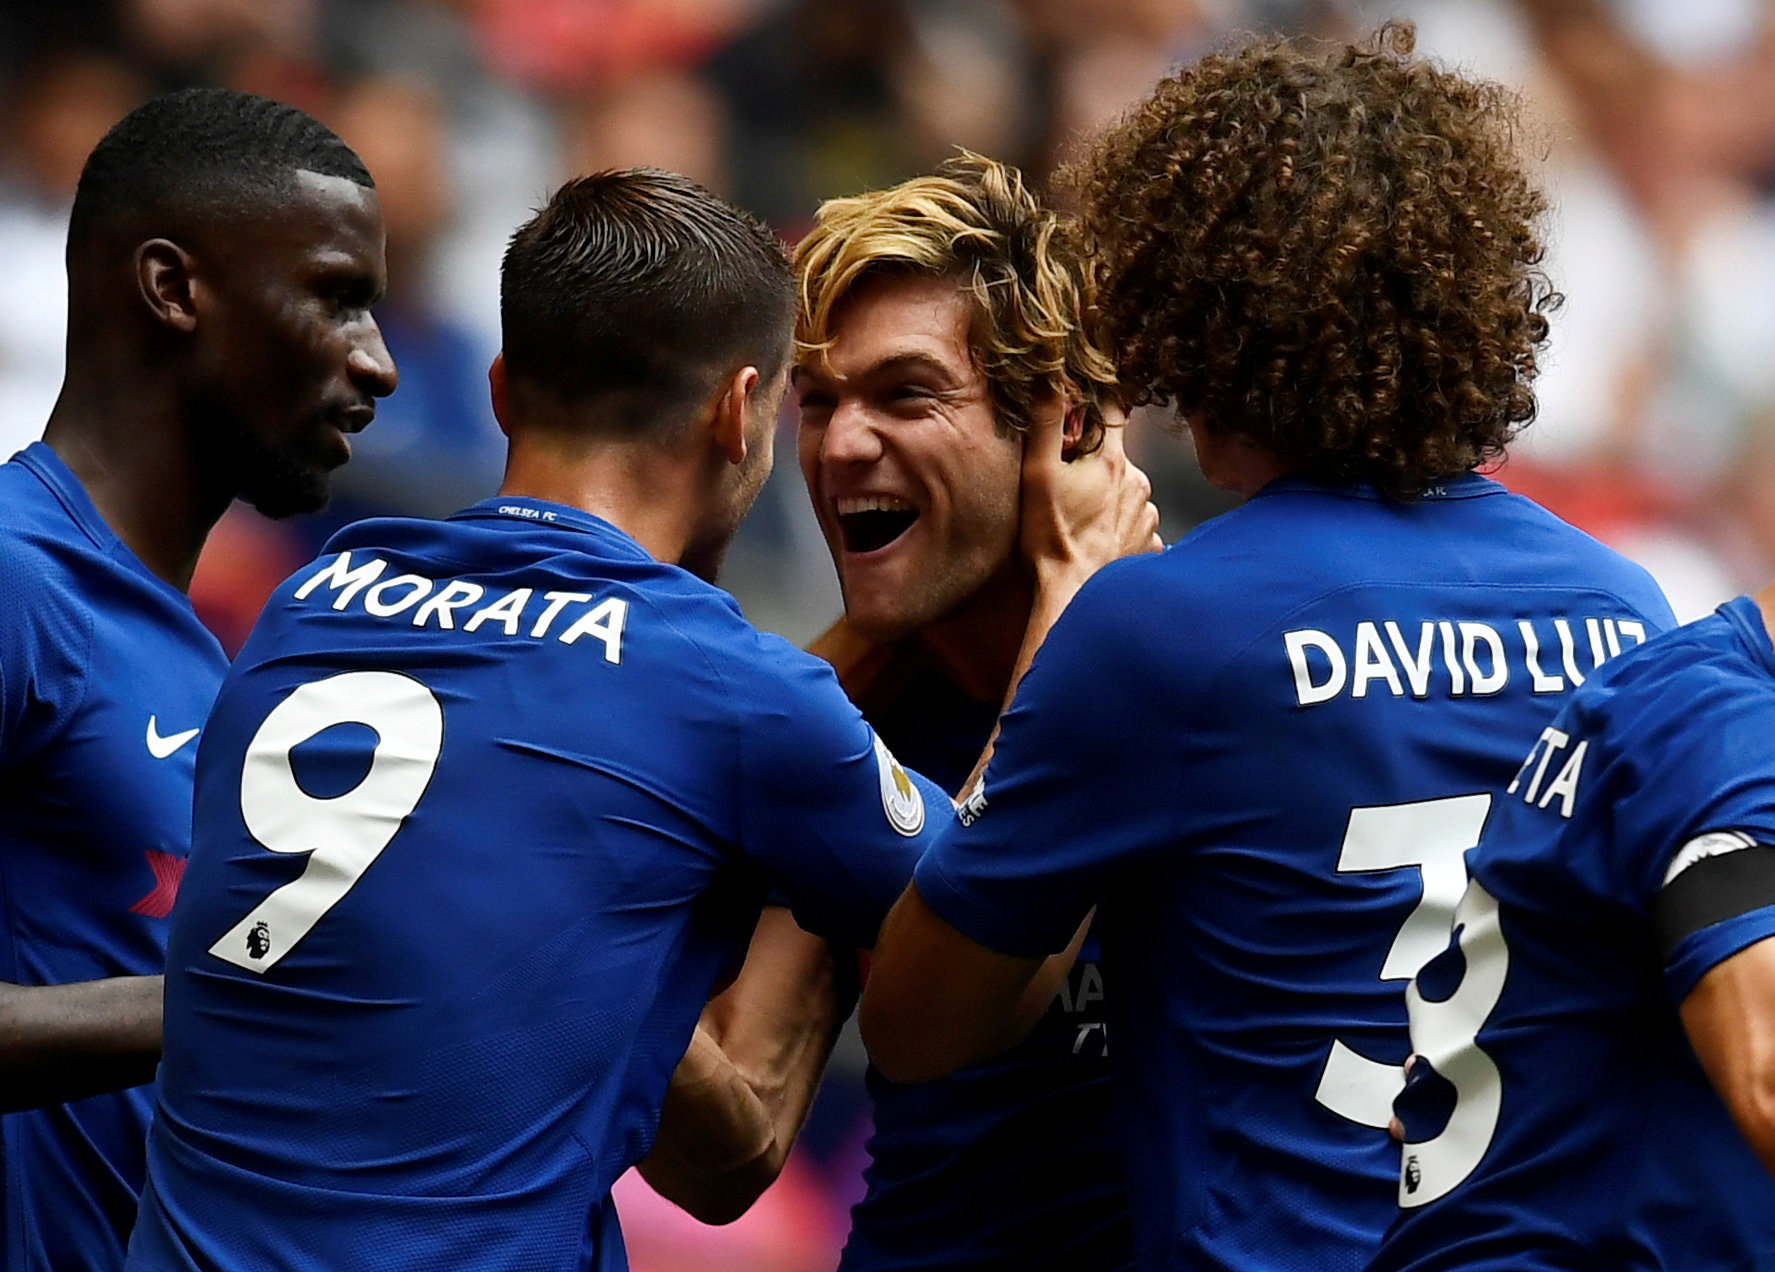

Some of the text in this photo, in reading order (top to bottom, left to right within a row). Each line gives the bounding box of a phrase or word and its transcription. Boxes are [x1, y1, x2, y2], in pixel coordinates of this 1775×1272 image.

[498, 505, 558, 521] CHELSEA FC
[293, 550, 629, 666] MORATA
[1283, 620, 1509, 706] DAVID
[208, 670, 444, 975] 9
[1315, 792, 1493, 1130] 3
